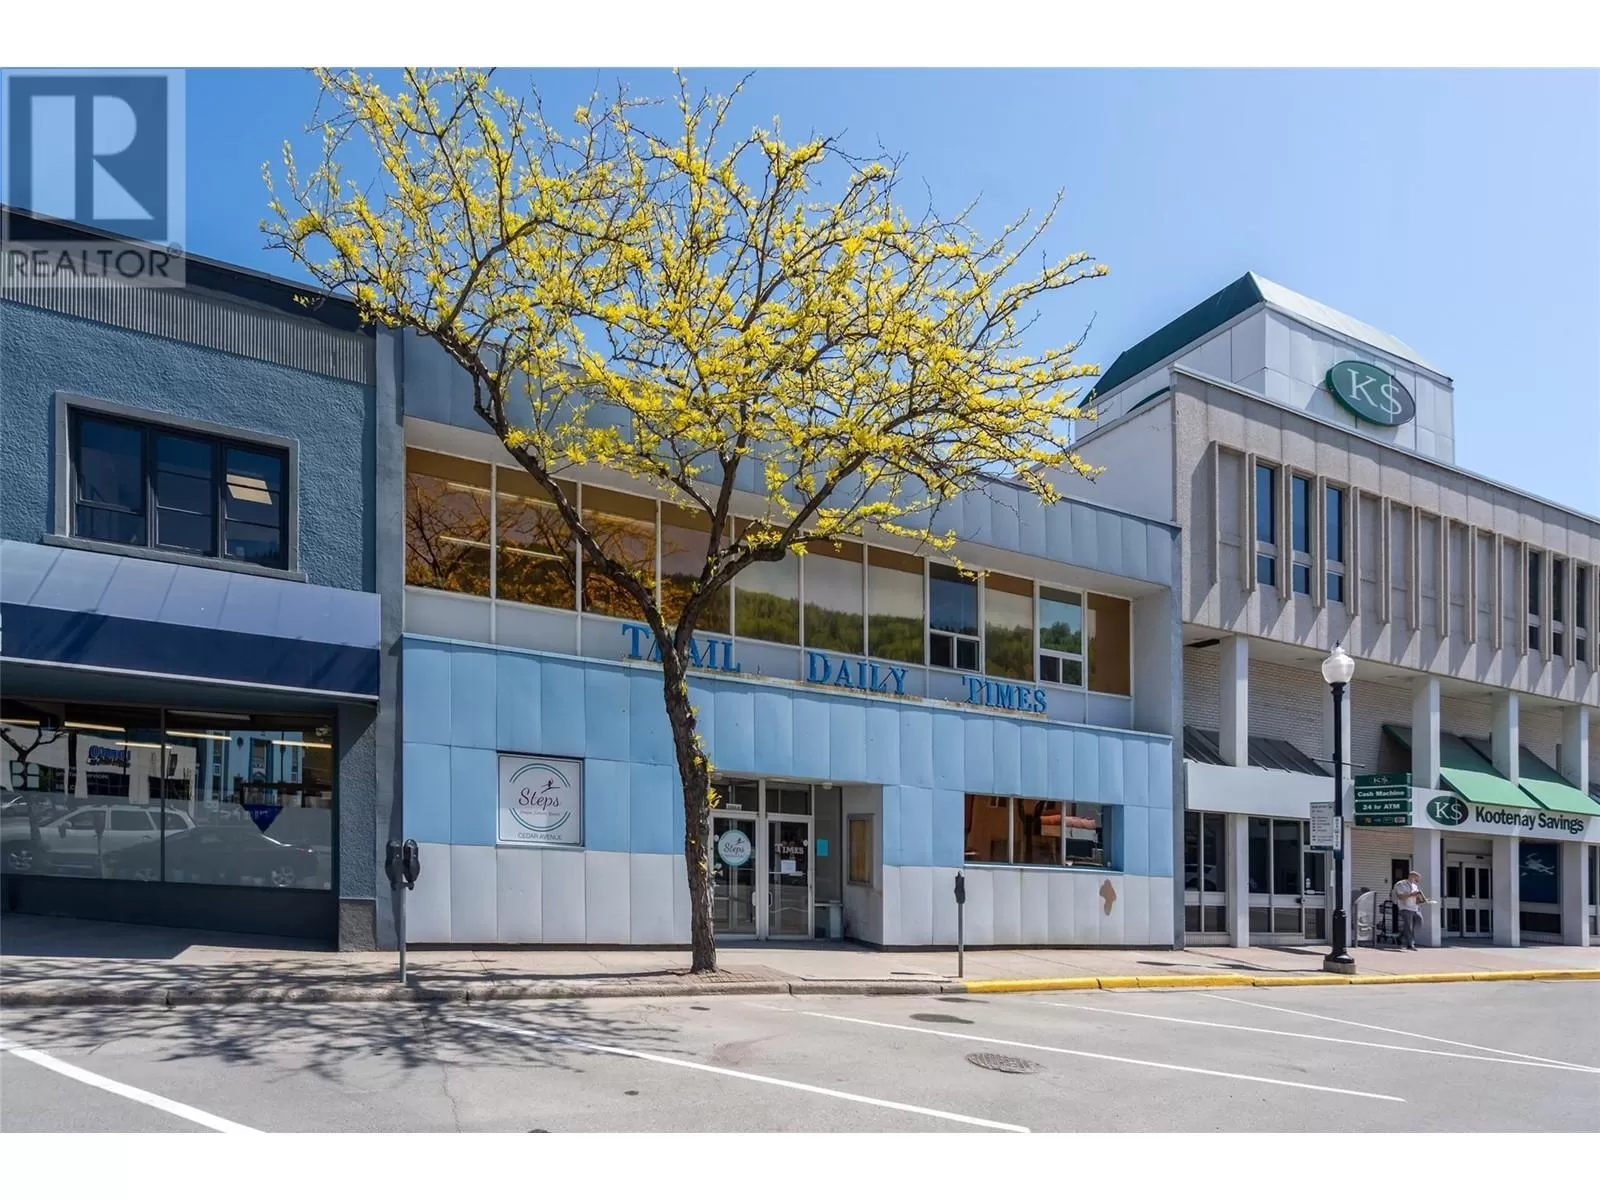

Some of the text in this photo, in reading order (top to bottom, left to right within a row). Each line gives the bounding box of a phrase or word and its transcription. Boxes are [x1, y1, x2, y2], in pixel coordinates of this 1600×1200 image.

[807, 651, 909, 696] DAILY
[962, 674, 1048, 714] TIMES
[518, 787, 560, 811] Steps
[1475, 806, 1537, 831] Kootenay
[1538, 812, 1584, 835] Savings
